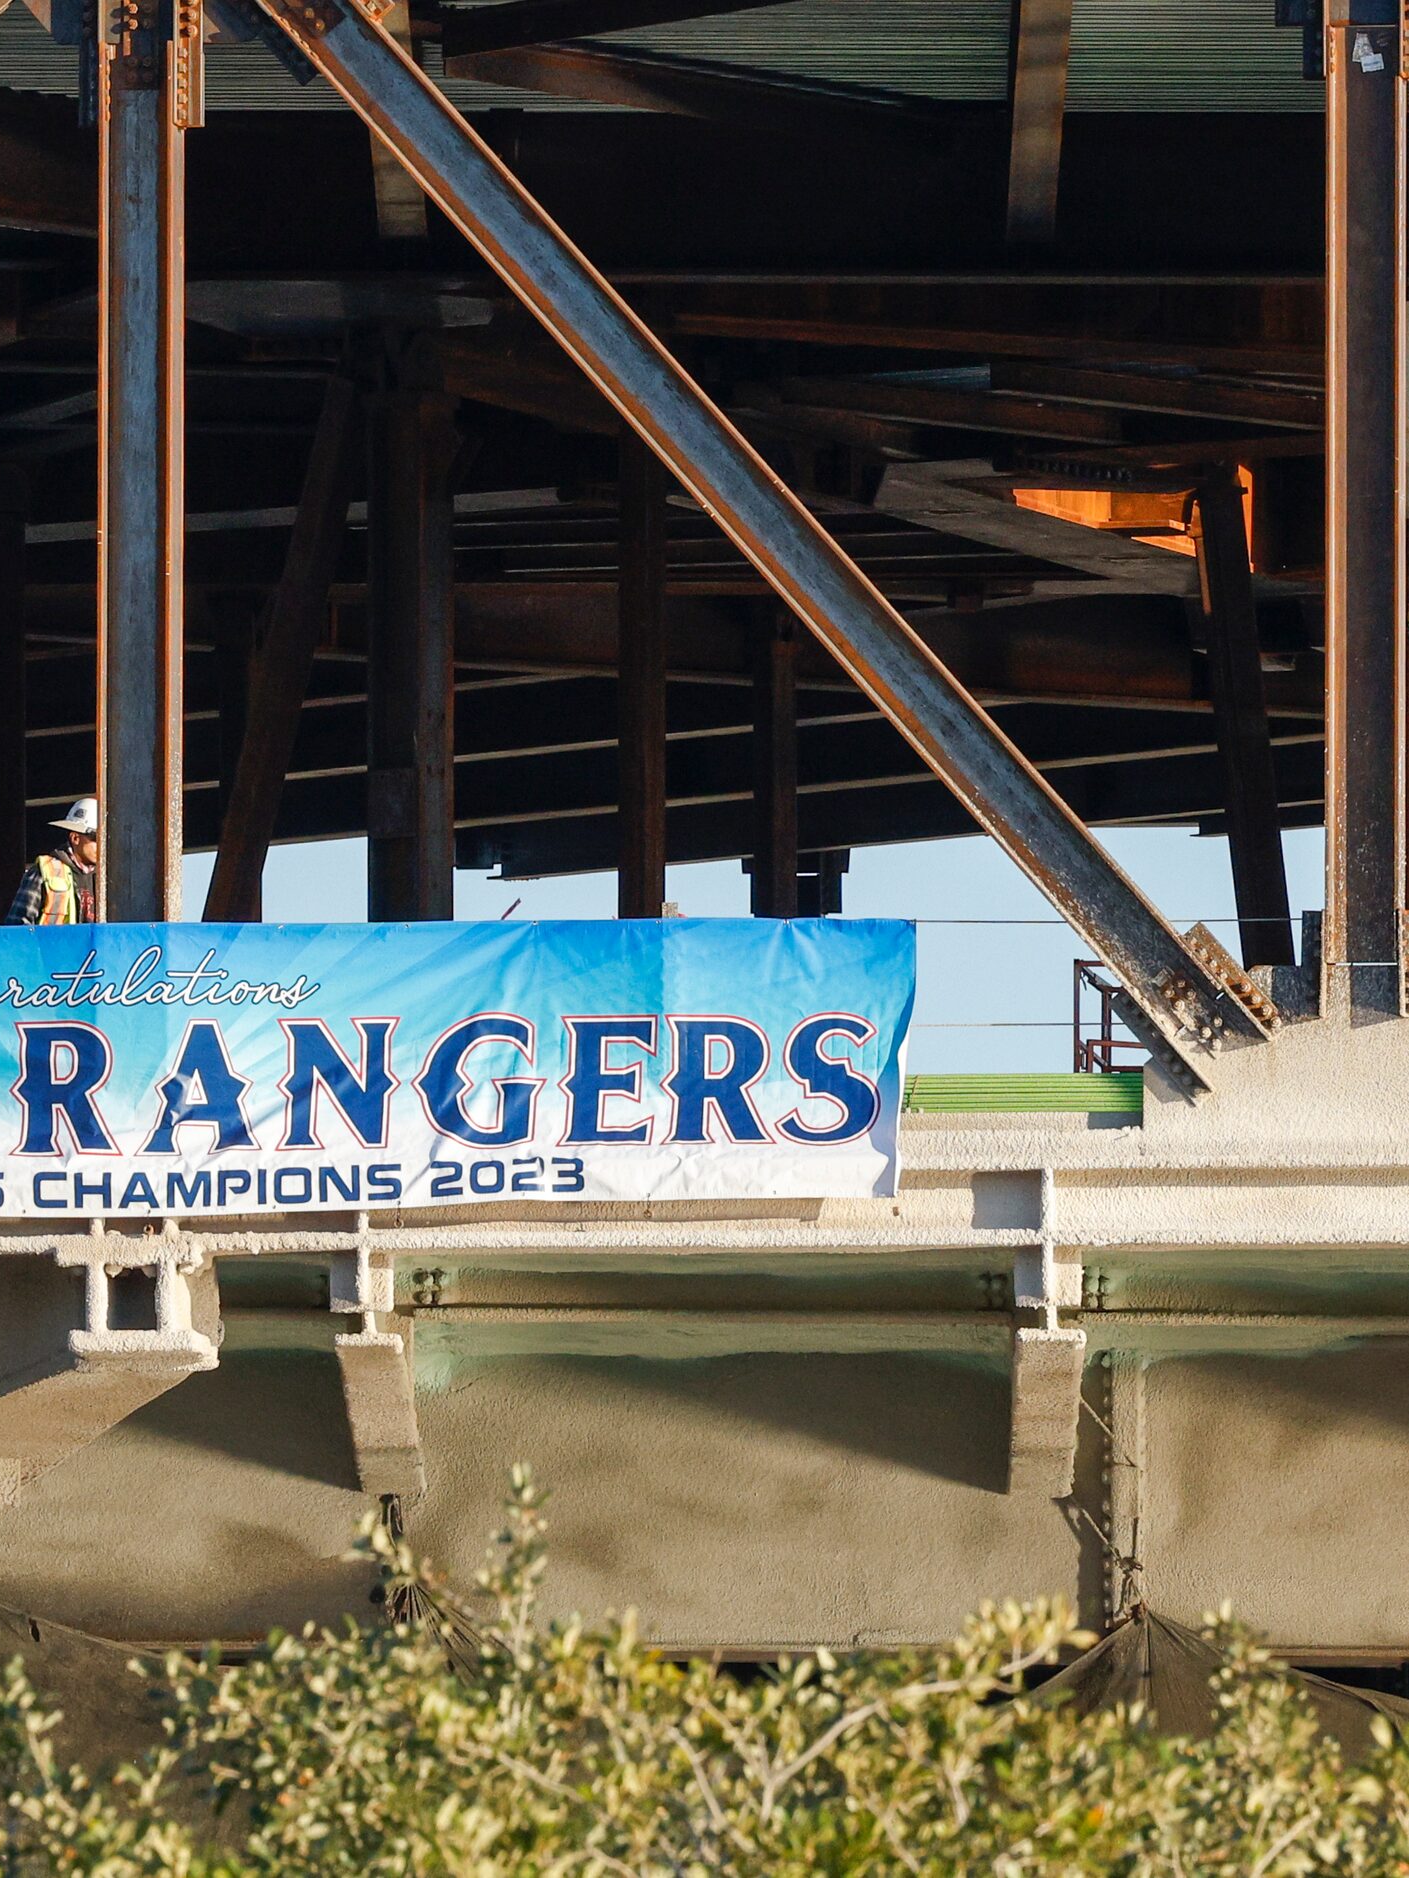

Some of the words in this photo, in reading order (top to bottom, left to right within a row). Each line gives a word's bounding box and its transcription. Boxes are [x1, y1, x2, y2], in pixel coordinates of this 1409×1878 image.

[9, 1012, 881, 1158] RANGERS
[32, 1160, 404, 1211] CHAMPIONS
[431, 1156, 586, 1196] 2023
